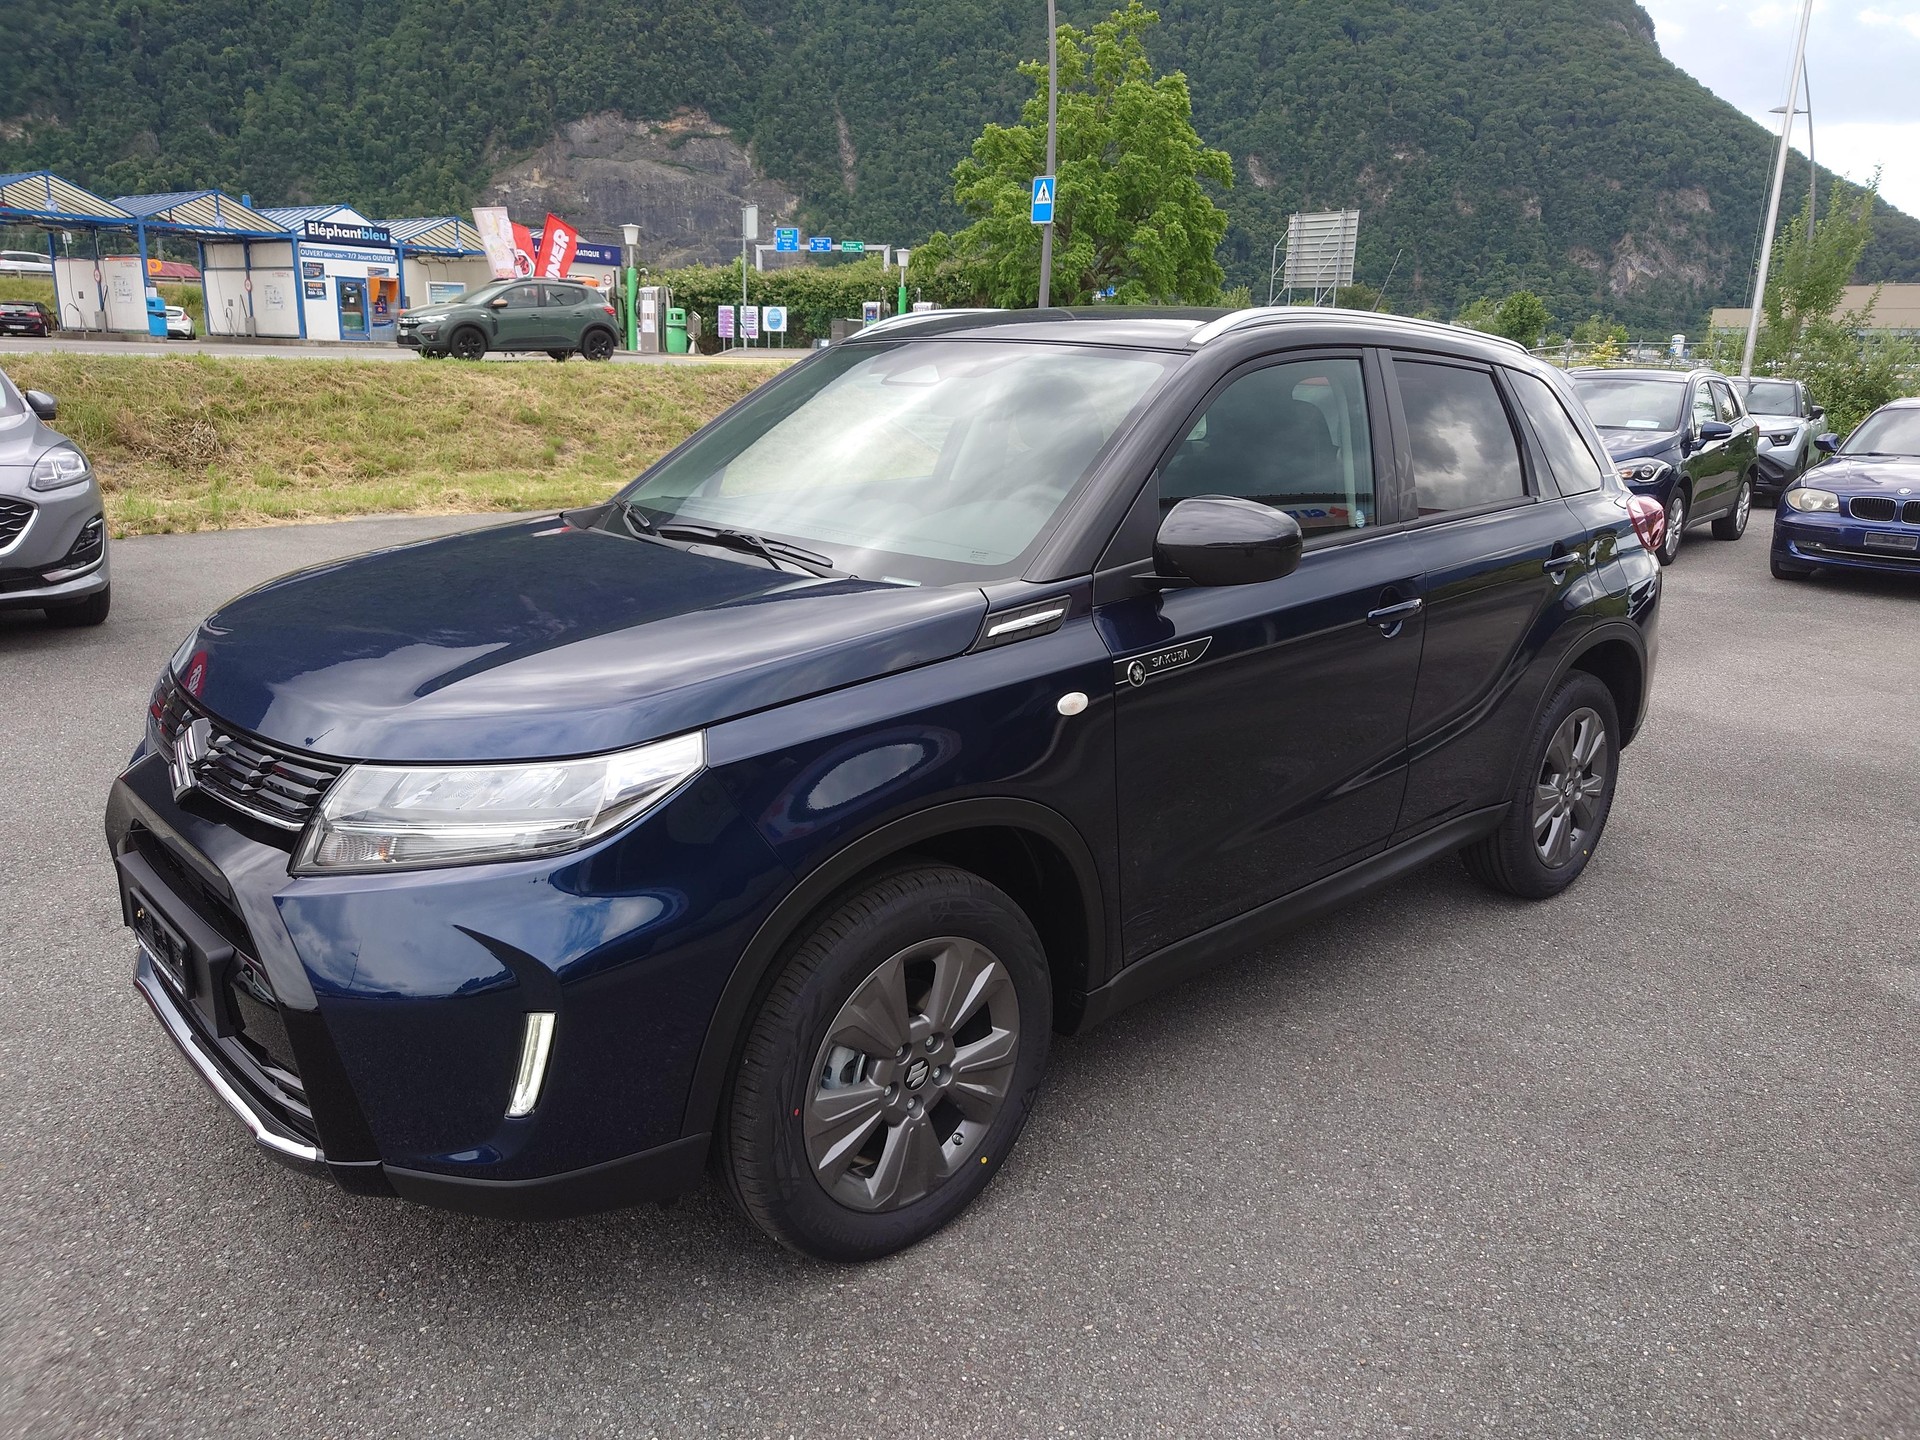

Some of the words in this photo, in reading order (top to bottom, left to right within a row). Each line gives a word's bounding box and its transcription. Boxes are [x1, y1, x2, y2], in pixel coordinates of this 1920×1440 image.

[300, 249, 324, 257] OUVERT
[372, 254, 394, 262] OUVERT
[1151, 649, 1190, 668] SAKURA
